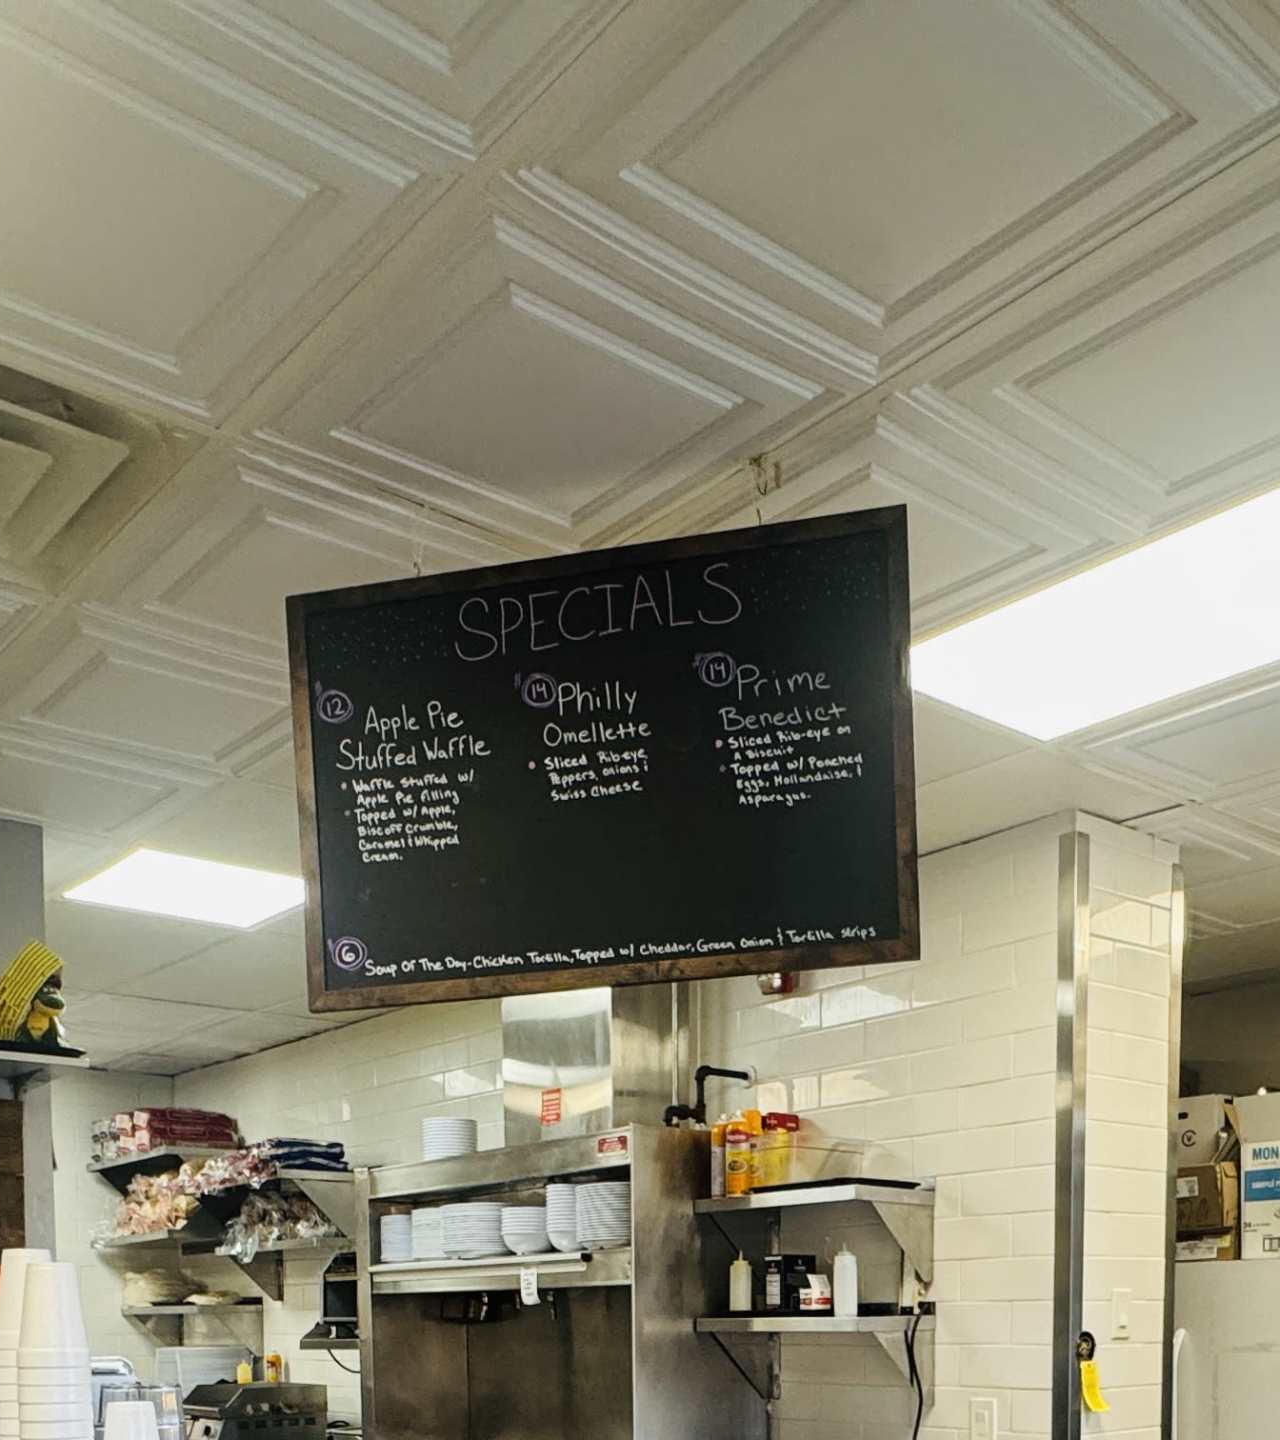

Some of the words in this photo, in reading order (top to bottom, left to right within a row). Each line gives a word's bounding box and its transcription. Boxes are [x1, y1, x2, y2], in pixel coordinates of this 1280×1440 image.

[455, 563, 743, 662] SPECIALS
[736, 664, 831, 700] Prime
[558, 680, 637, 716] Philly
[365, 703, 419, 741] Apple
[427, 700, 464, 730] Pie
[718, 702, 847, 731] Benedict
[543, 721, 652, 747] Omellette
[727, 734, 772, 749] Sliced
[837, 725, 851, 735] on
[336, 738, 417, 772] Stuffed
[422, 734, 491, 761] Waffle
[543, 753, 588, 770] Sliced
[730, 761, 779, 777] Topped
[786, 756, 803, 770] w/
[807, 753, 863, 769] Poached
[745, 745, 794, 759] Biscuit
[356, 794, 389, 808] Apple
[395, 791, 414, 805] Pie
[550, 789, 587, 801] Swiss
[590, 780, 643, 797] Cheese
[354, 808, 396, 825] Topped
[403, 804, 418, 818] w/
[365, 959, 398, 978] Soup
[419, 957, 444, 971] The
[572, 947, 615, 964] Topped
[696, 938, 736, 952] Green
